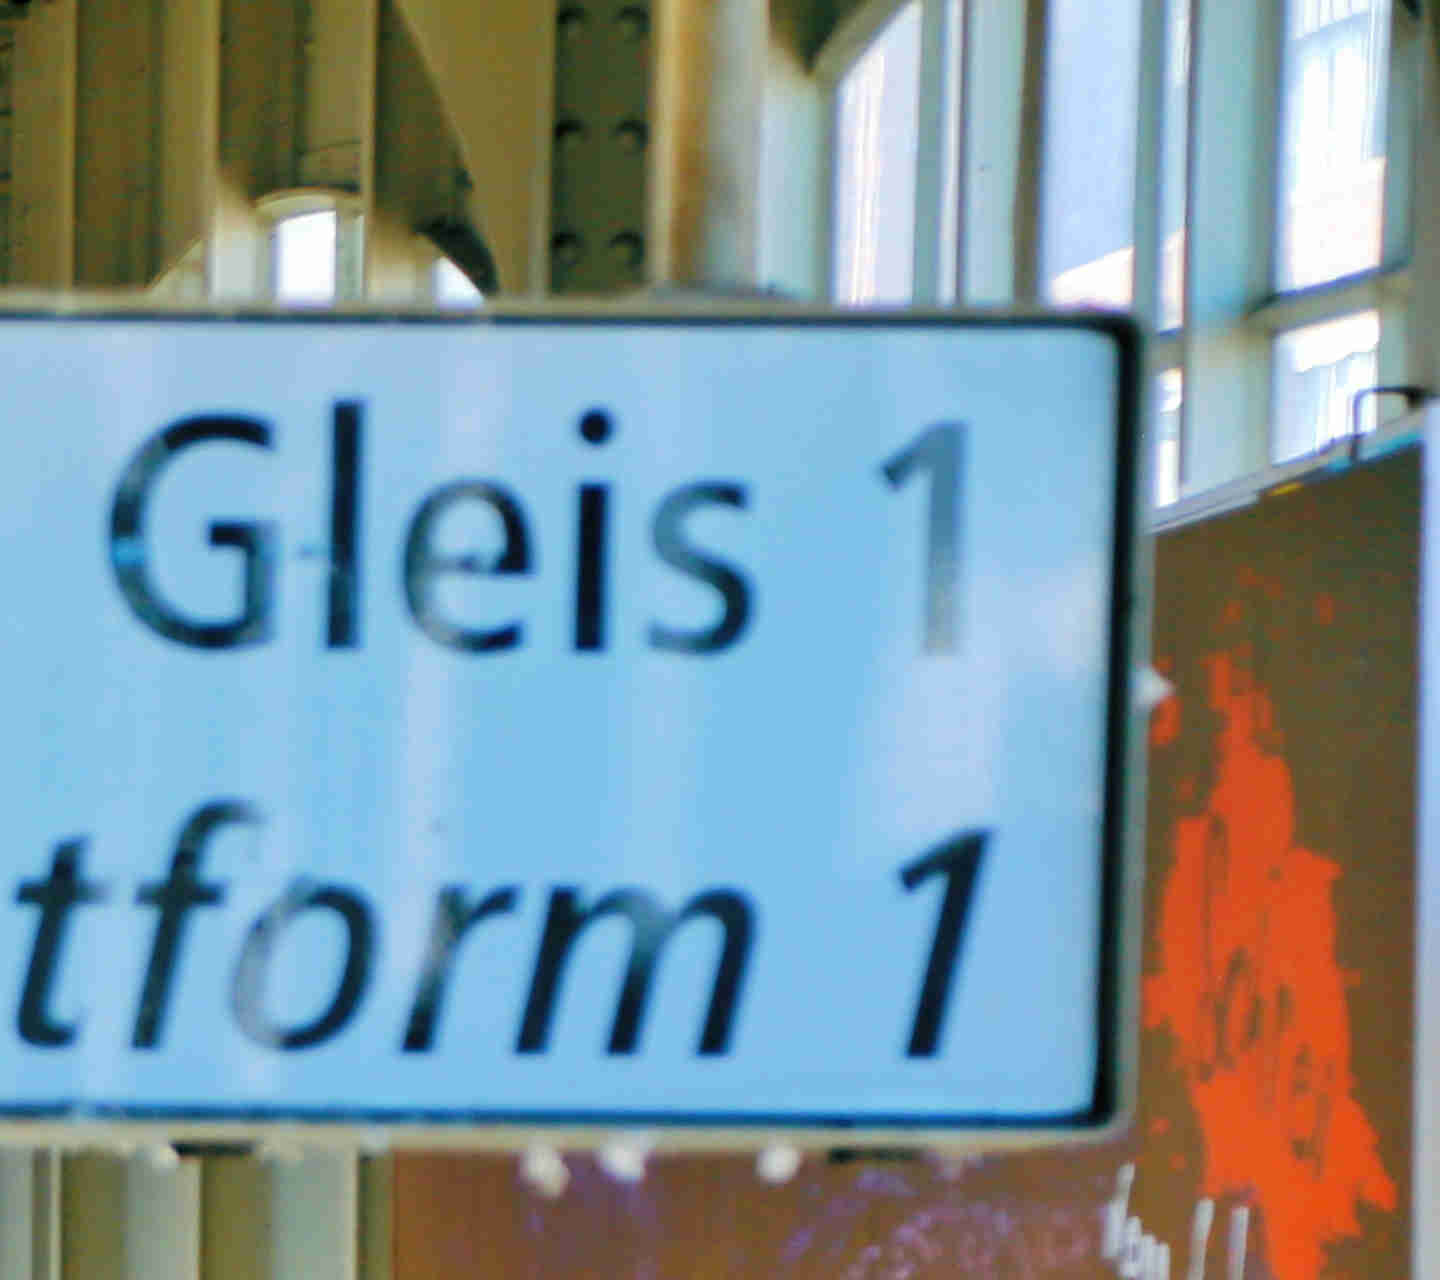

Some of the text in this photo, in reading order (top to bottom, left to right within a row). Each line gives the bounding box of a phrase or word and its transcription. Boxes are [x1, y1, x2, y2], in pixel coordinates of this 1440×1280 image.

[104, 396, 972, 656] Gleis 1
[894, 824, 996, 1060] 1
